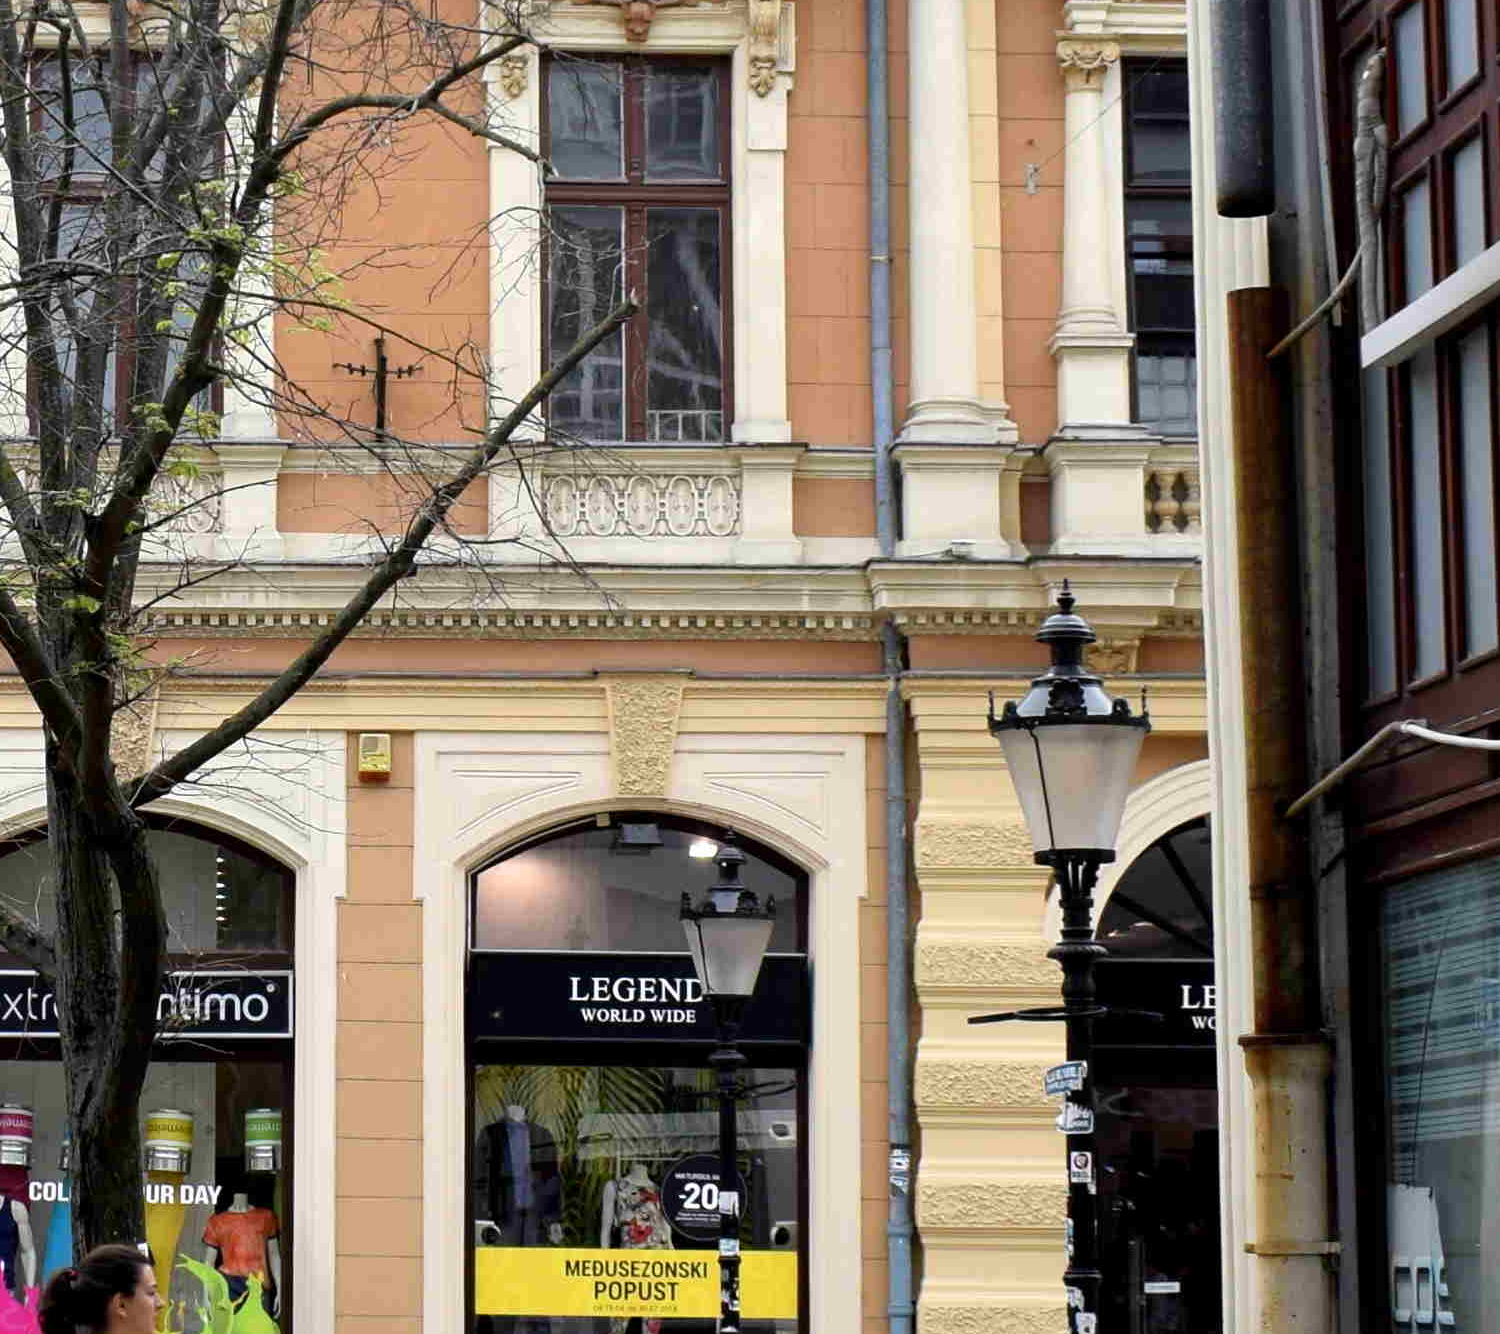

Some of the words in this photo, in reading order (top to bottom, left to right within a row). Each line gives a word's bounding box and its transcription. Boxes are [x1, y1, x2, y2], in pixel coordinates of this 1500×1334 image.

[569, 976, 703, 1003] LEGEND
[1180, 984, 1216, 1010] LE
[155, 987, 270, 1022] ntimo
[580, 1008, 645, 1023] WORLD
[650, 1009, 697, 1024] WIDE
[28, 1181, 69, 1202] COL
[143, 1184, 174, 1205] UR
[180, 1184, 223, 1205] DAY
[678, 1182, 719, 1211] -20
[594, 1280, 679, 1301] POPUST
